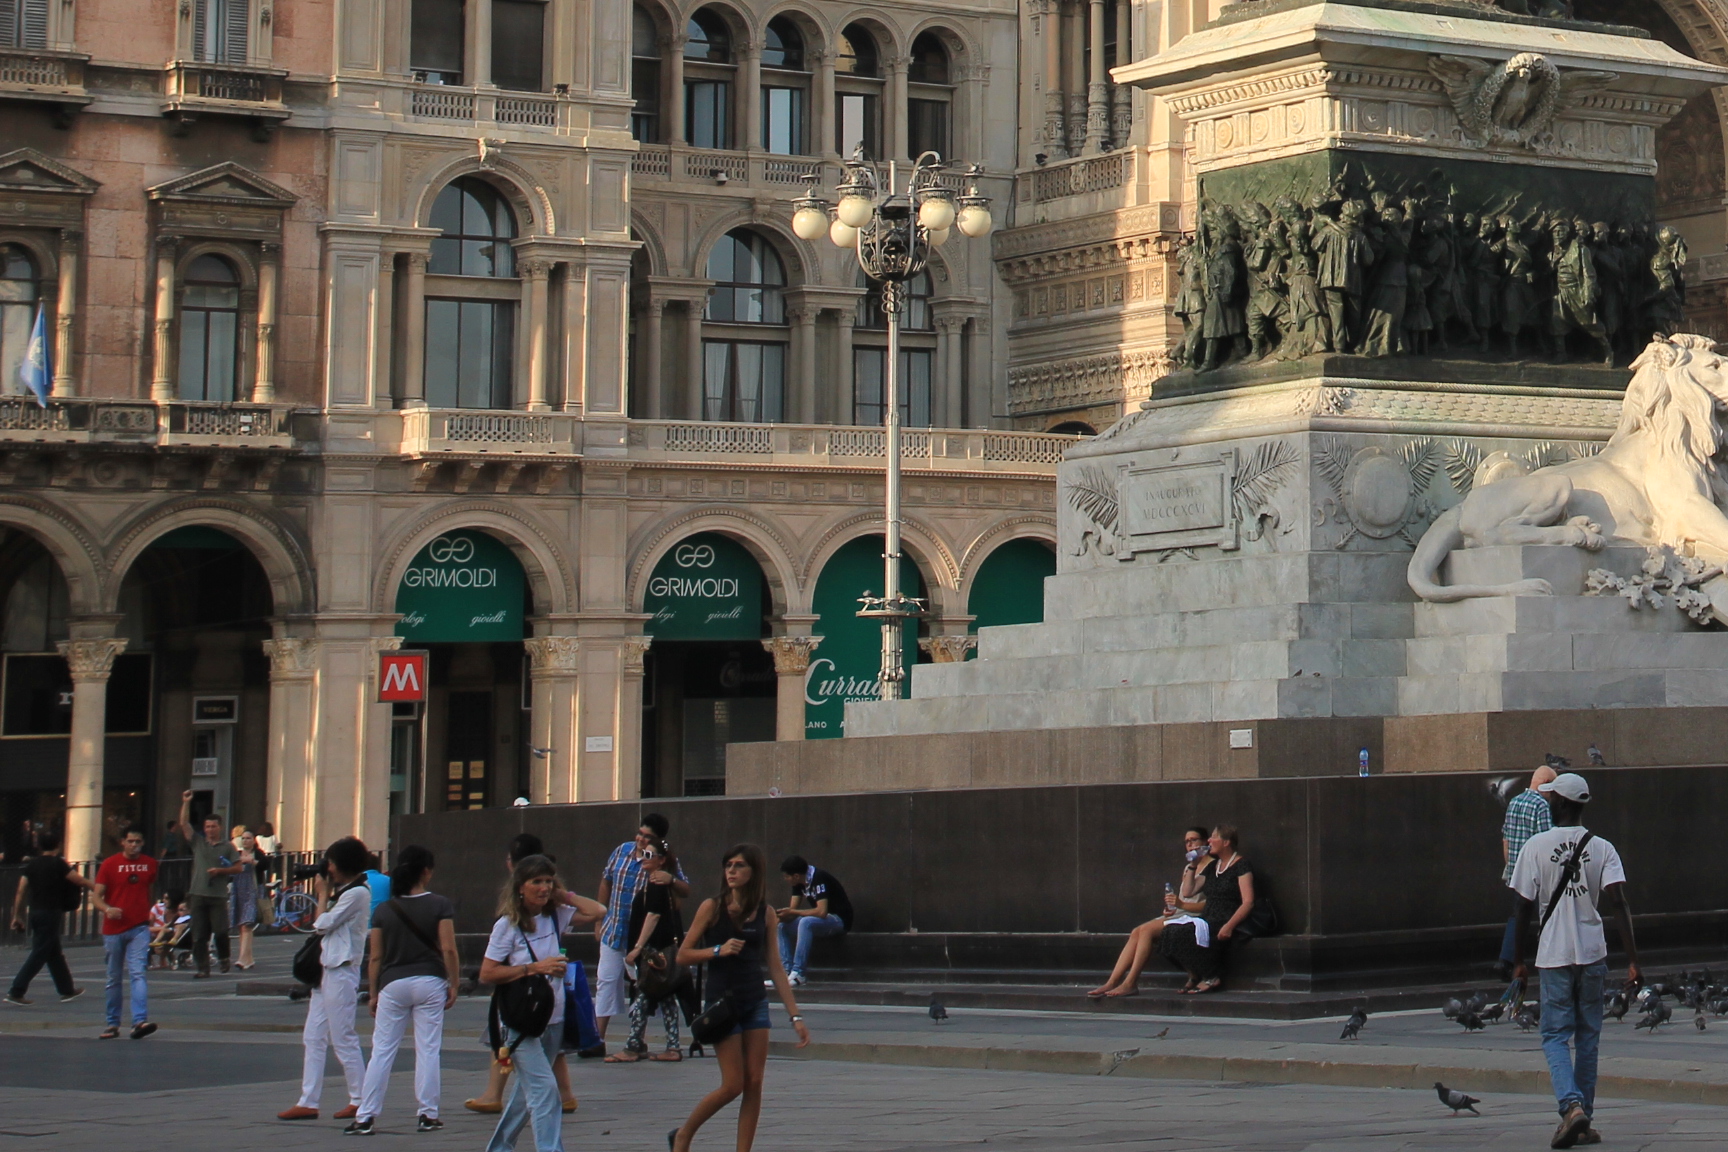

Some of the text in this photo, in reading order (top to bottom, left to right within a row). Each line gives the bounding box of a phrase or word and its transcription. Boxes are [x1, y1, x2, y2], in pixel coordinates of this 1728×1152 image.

[404, 568, 497, 588] GRIMOLDI
[649, 577, 739, 597] GRIMOLDI
[401, 610, 507, 628] ologi gioielli
[382, 663, 420, 691] M
[118, 864, 149, 873] FITCH
